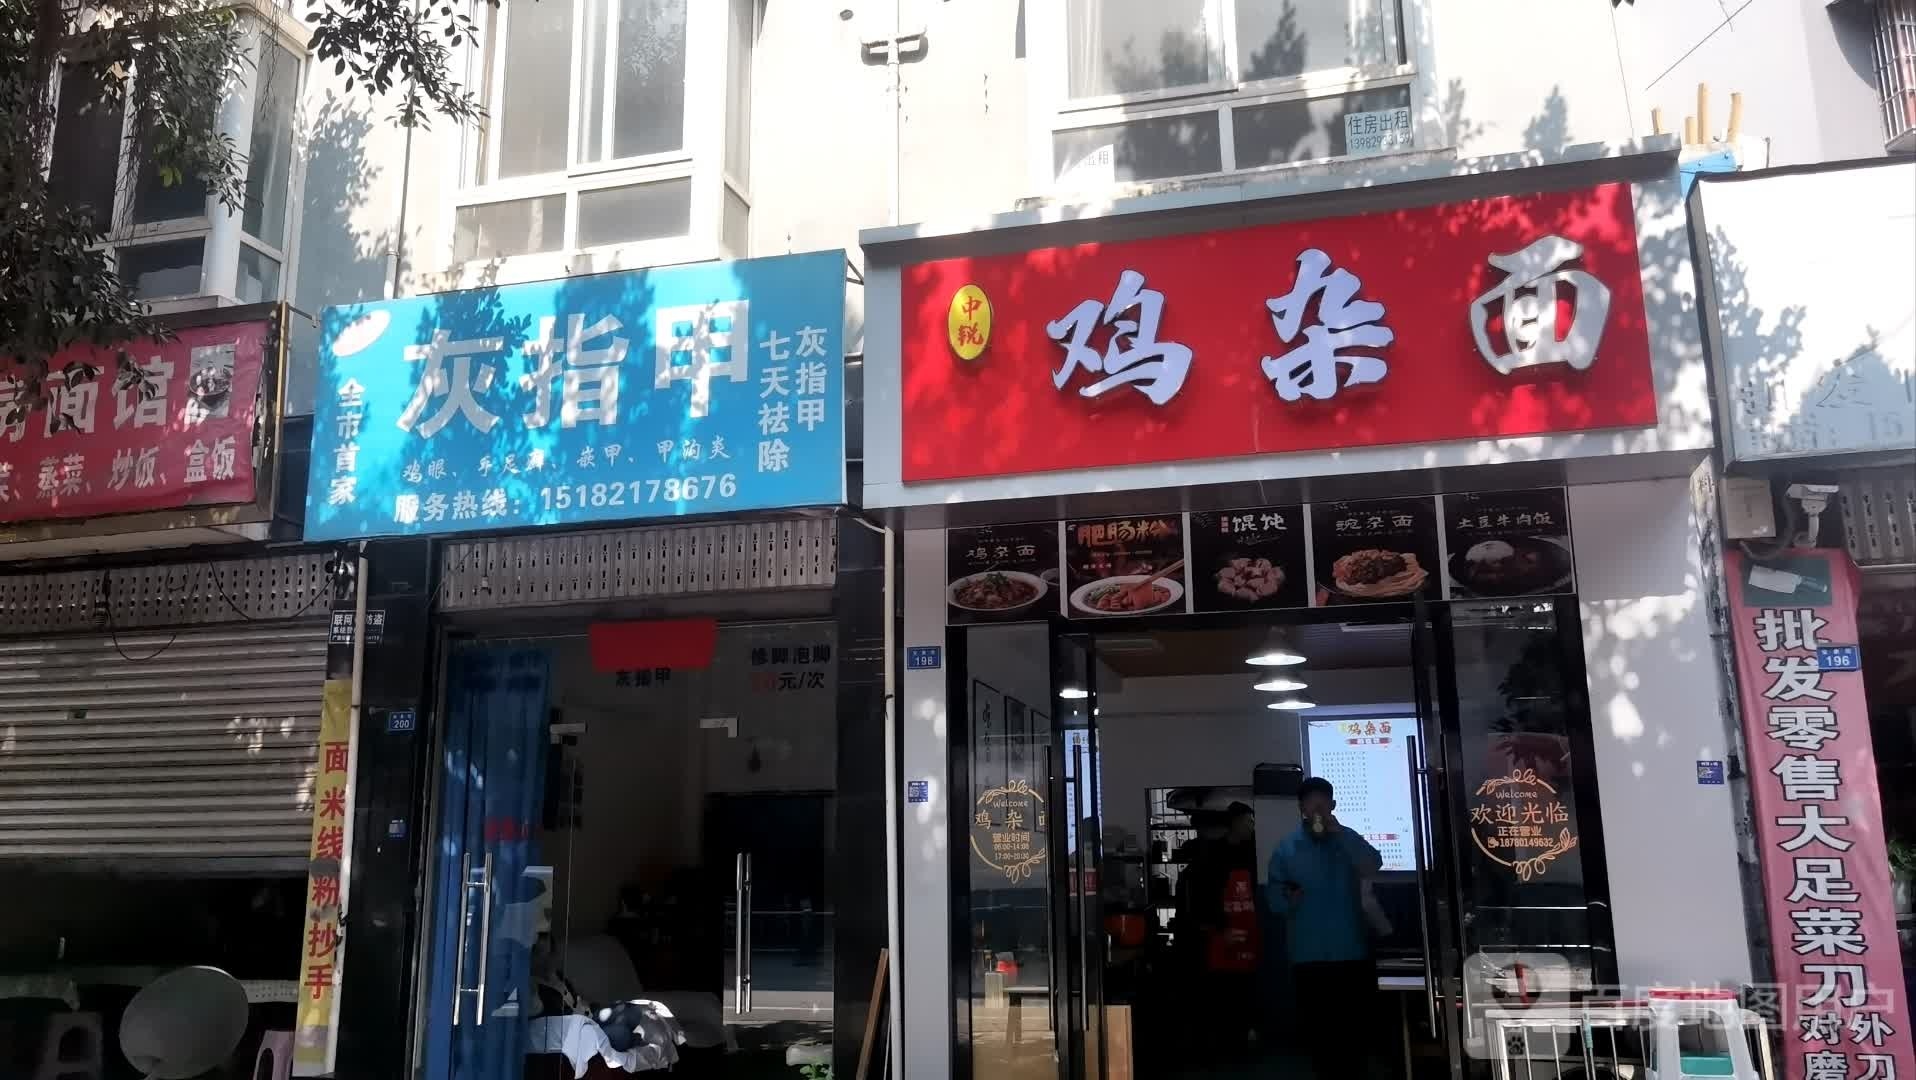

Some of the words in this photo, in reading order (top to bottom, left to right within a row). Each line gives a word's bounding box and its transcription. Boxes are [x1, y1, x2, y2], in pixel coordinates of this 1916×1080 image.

[1348, 110, 1409, 136] 住房出租
[1046, 234, 1611, 405] 鸡杂面
[396, 299, 750, 439] 灰指甲
[795, 325, 828, 432] 灰指甲
[757, 330, 790, 473] 七天祛除
[328, 378, 366, 505] 全市首家
[1077, 518, 1171, 547] 肥肠粉
[1231, 513, 1289, 533] 馄饨
[966, 544, 1036, 560] 鸡杂面
[914, 655, 934, 666] 198
[1825, 655, 1851, 667] 196
[391, 719, 411, 729] 200
[1470, 802, 1569, 825] 欢迎光临
[1753, 608, 1869, 1009] 批发零售大足菜刀
[992, 832, 1030, 843] 营业时间
[1497, 825, 1542, 837] 正在营业
